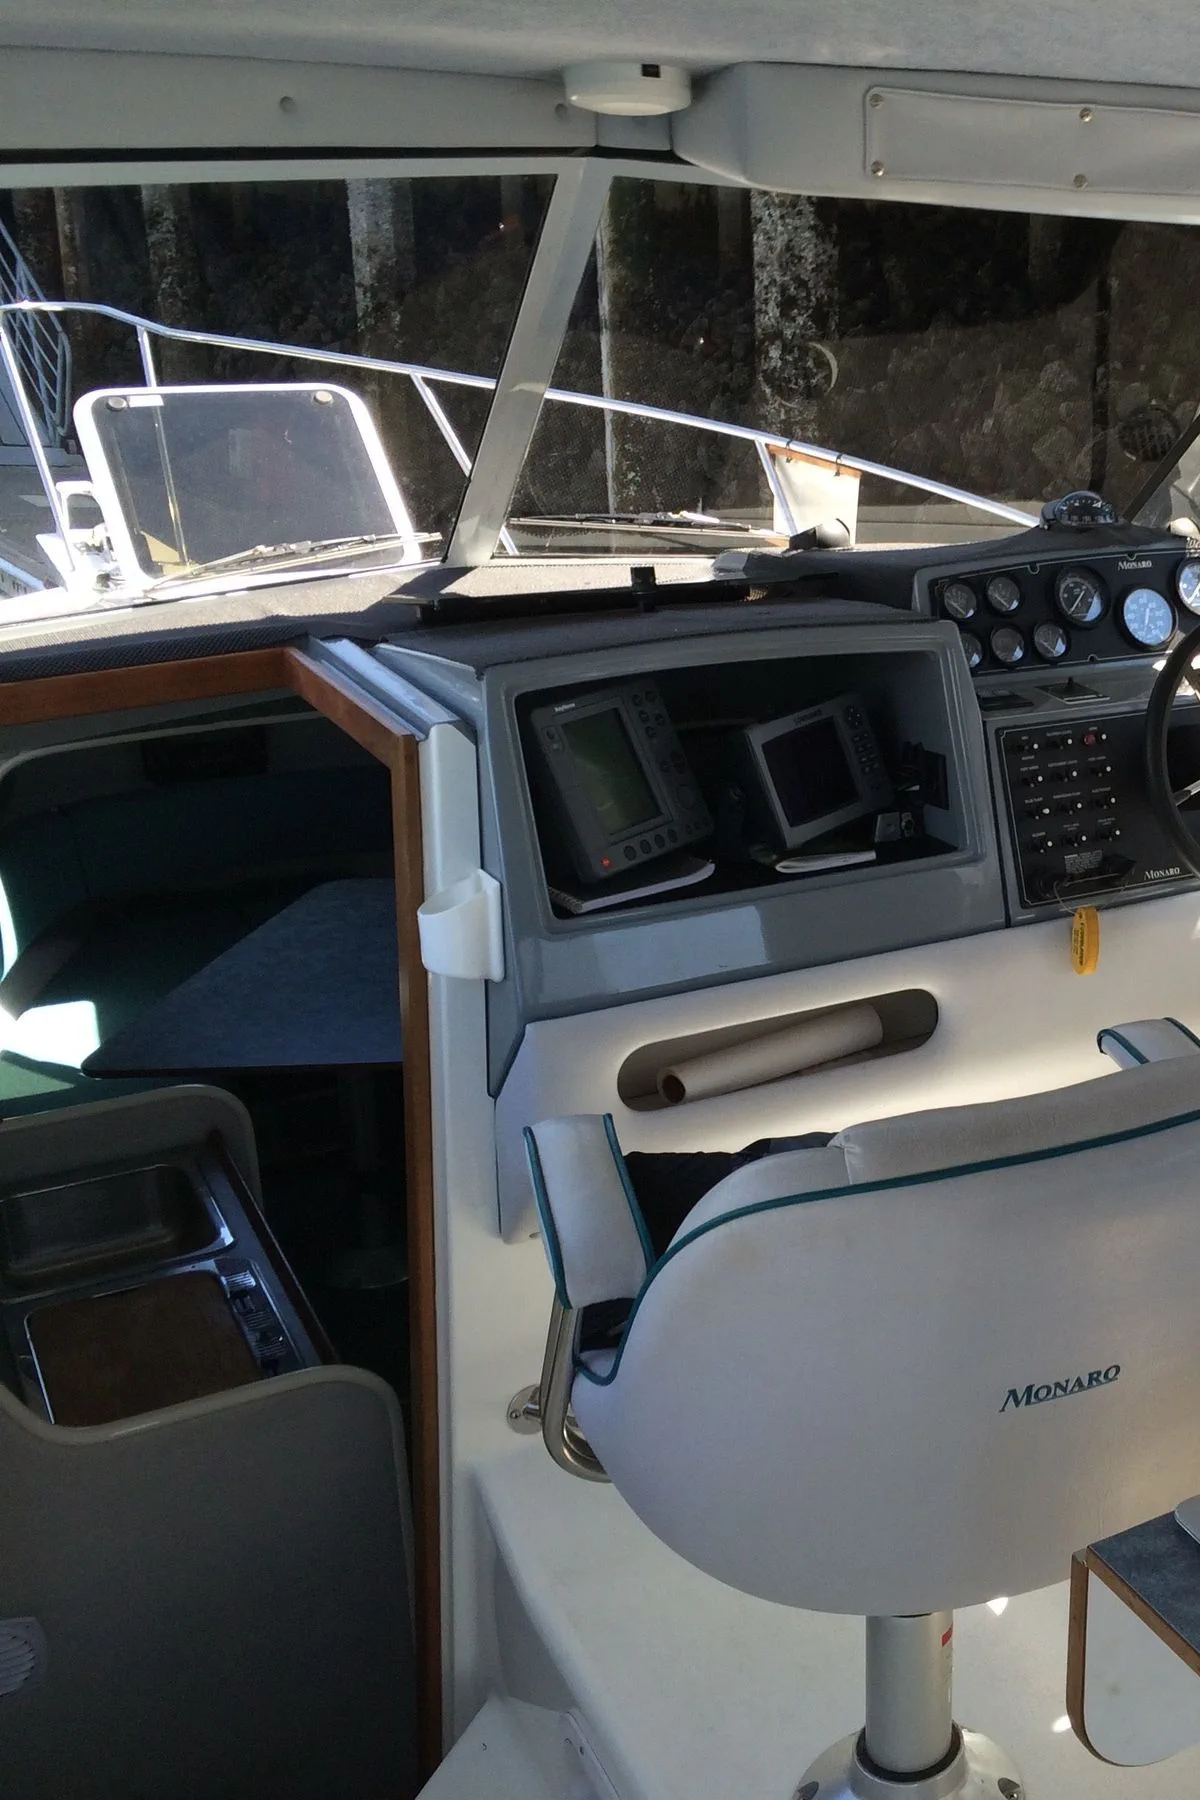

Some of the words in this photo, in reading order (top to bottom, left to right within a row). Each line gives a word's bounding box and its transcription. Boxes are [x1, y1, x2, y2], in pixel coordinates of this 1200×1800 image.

[1117, 560, 1152, 571] MONARO
[1143, 866, 1180, 881] MONARO
[998, 1364, 1121, 1413] MONARO
